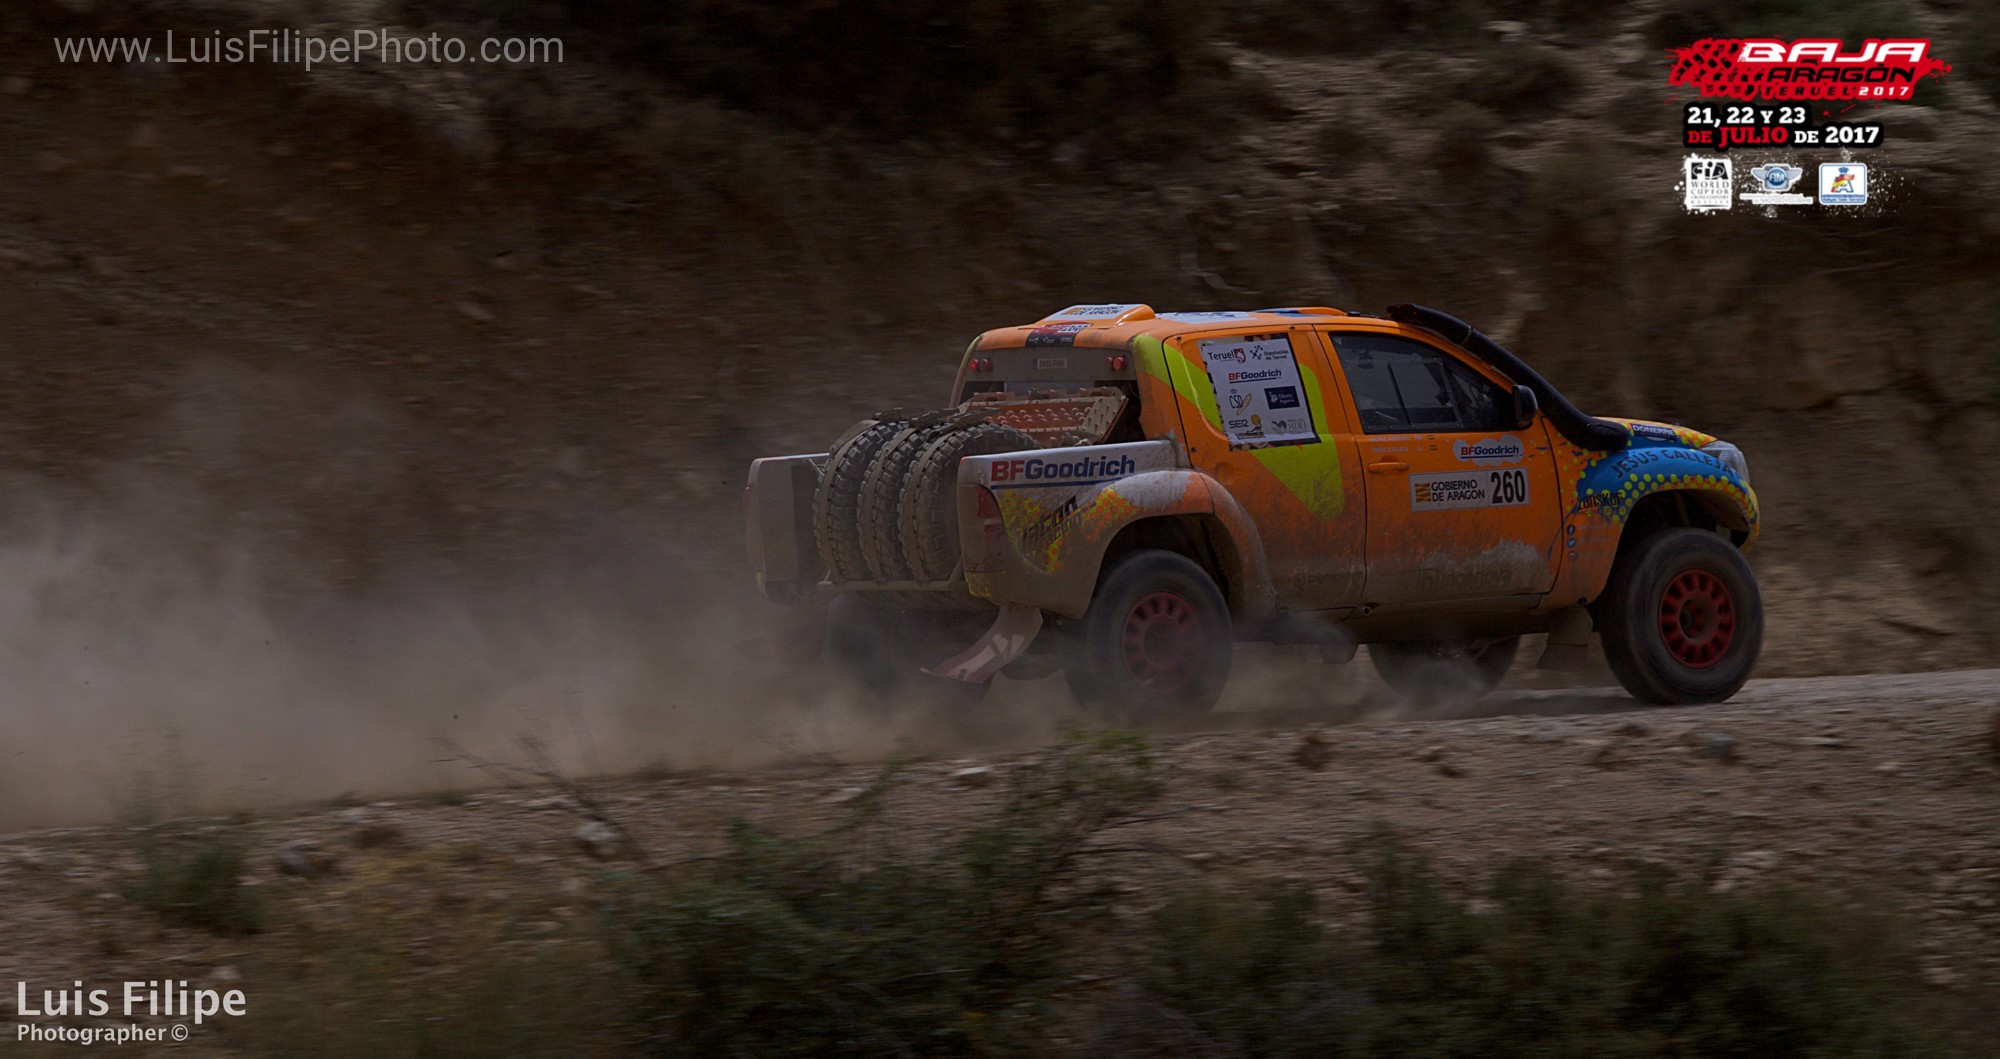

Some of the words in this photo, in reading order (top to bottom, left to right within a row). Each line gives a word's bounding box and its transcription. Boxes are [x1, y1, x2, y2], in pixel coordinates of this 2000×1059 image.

[1208, 350, 1235, 361] Teruel
[1228, 369, 1282, 381] BFGoodrich
[1229, 419, 1249, 429] SER
[1460, 445, 1519, 456] BFGoodrich
[991, 455, 1135, 482] BFGoodrich
[1661, 449, 1734, 477] CALLEJA
[1431, 479, 1478, 491] GOBIERNO
[1490, 470, 1526, 504] 260
[1432, 492, 1444, 502] DE
